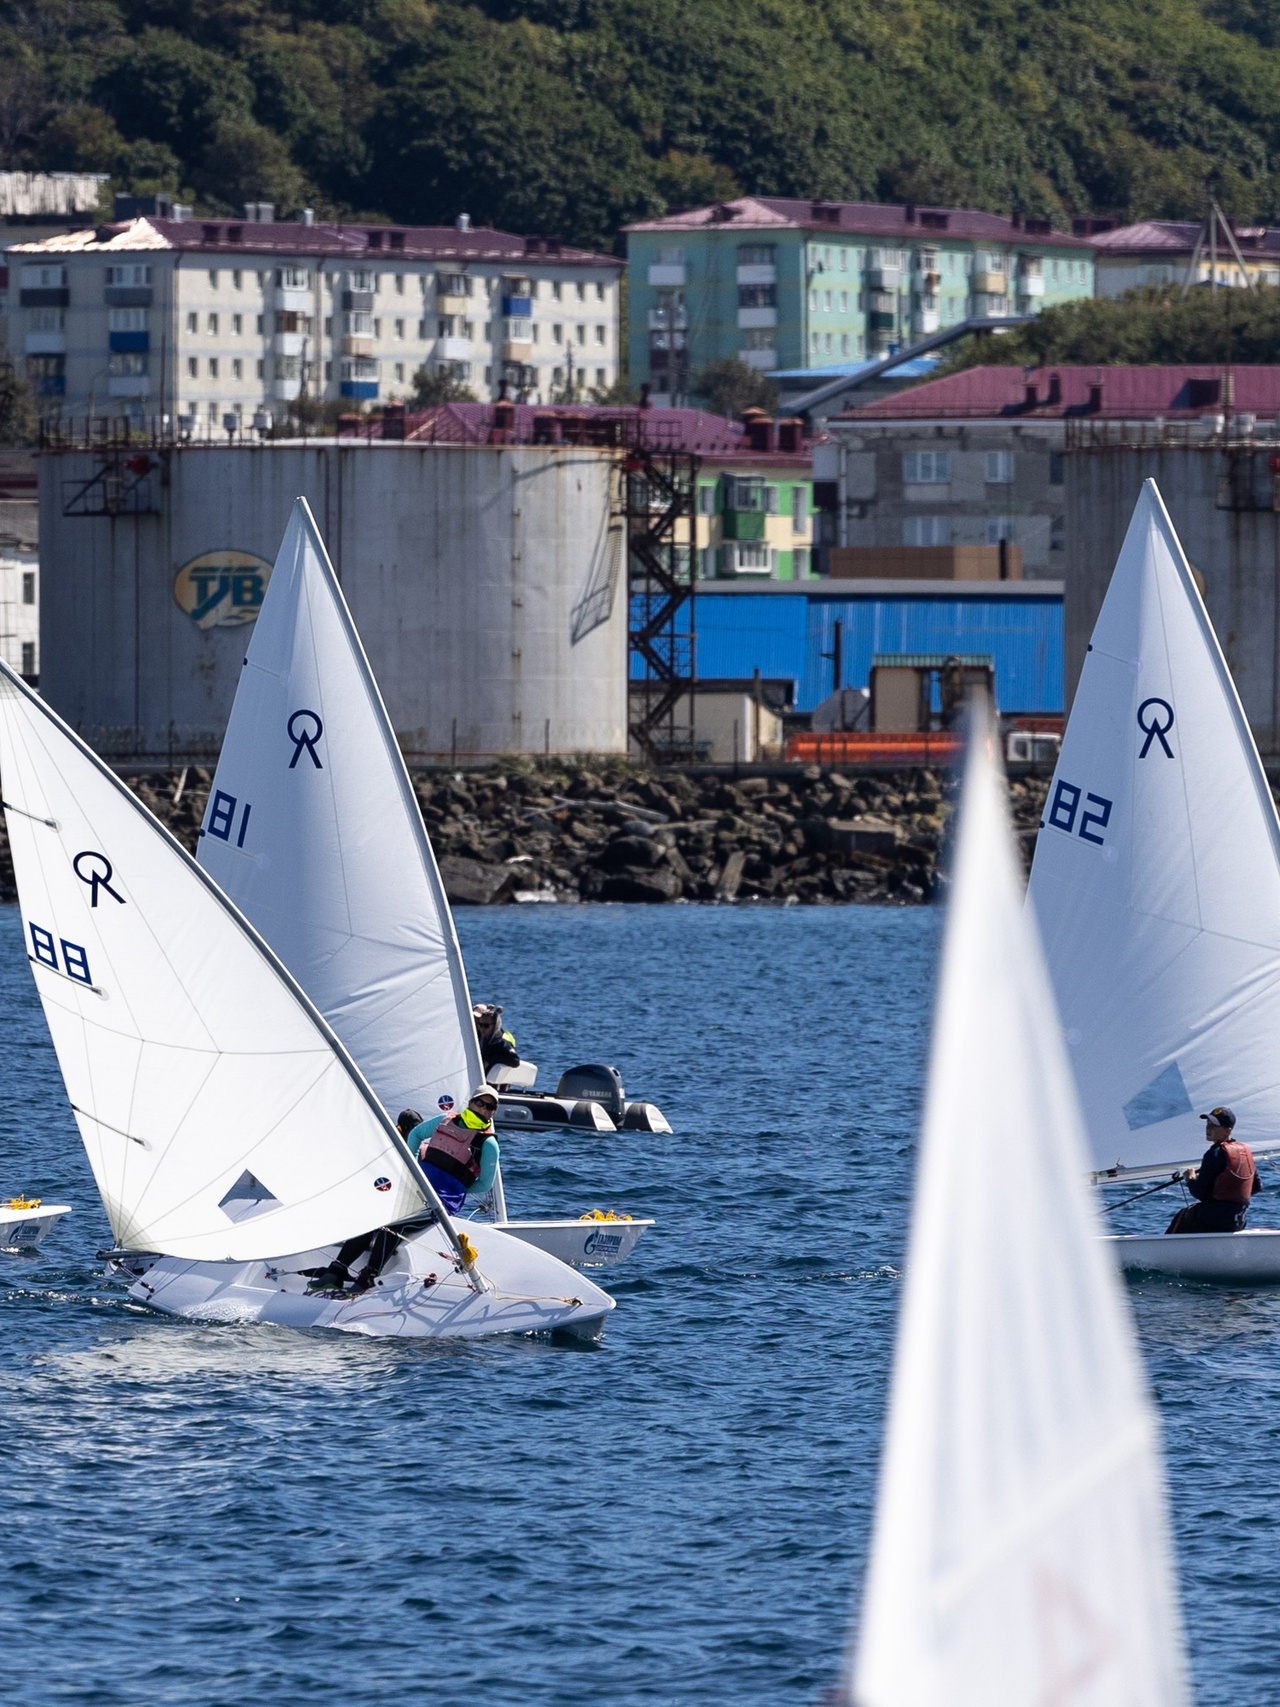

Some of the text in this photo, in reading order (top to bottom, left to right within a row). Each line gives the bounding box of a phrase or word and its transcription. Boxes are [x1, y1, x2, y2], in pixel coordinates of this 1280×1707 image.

[207, 788, 252, 849] 81
[1048, 779, 1113, 846] 82
[28, 921, 93, 986] 88
